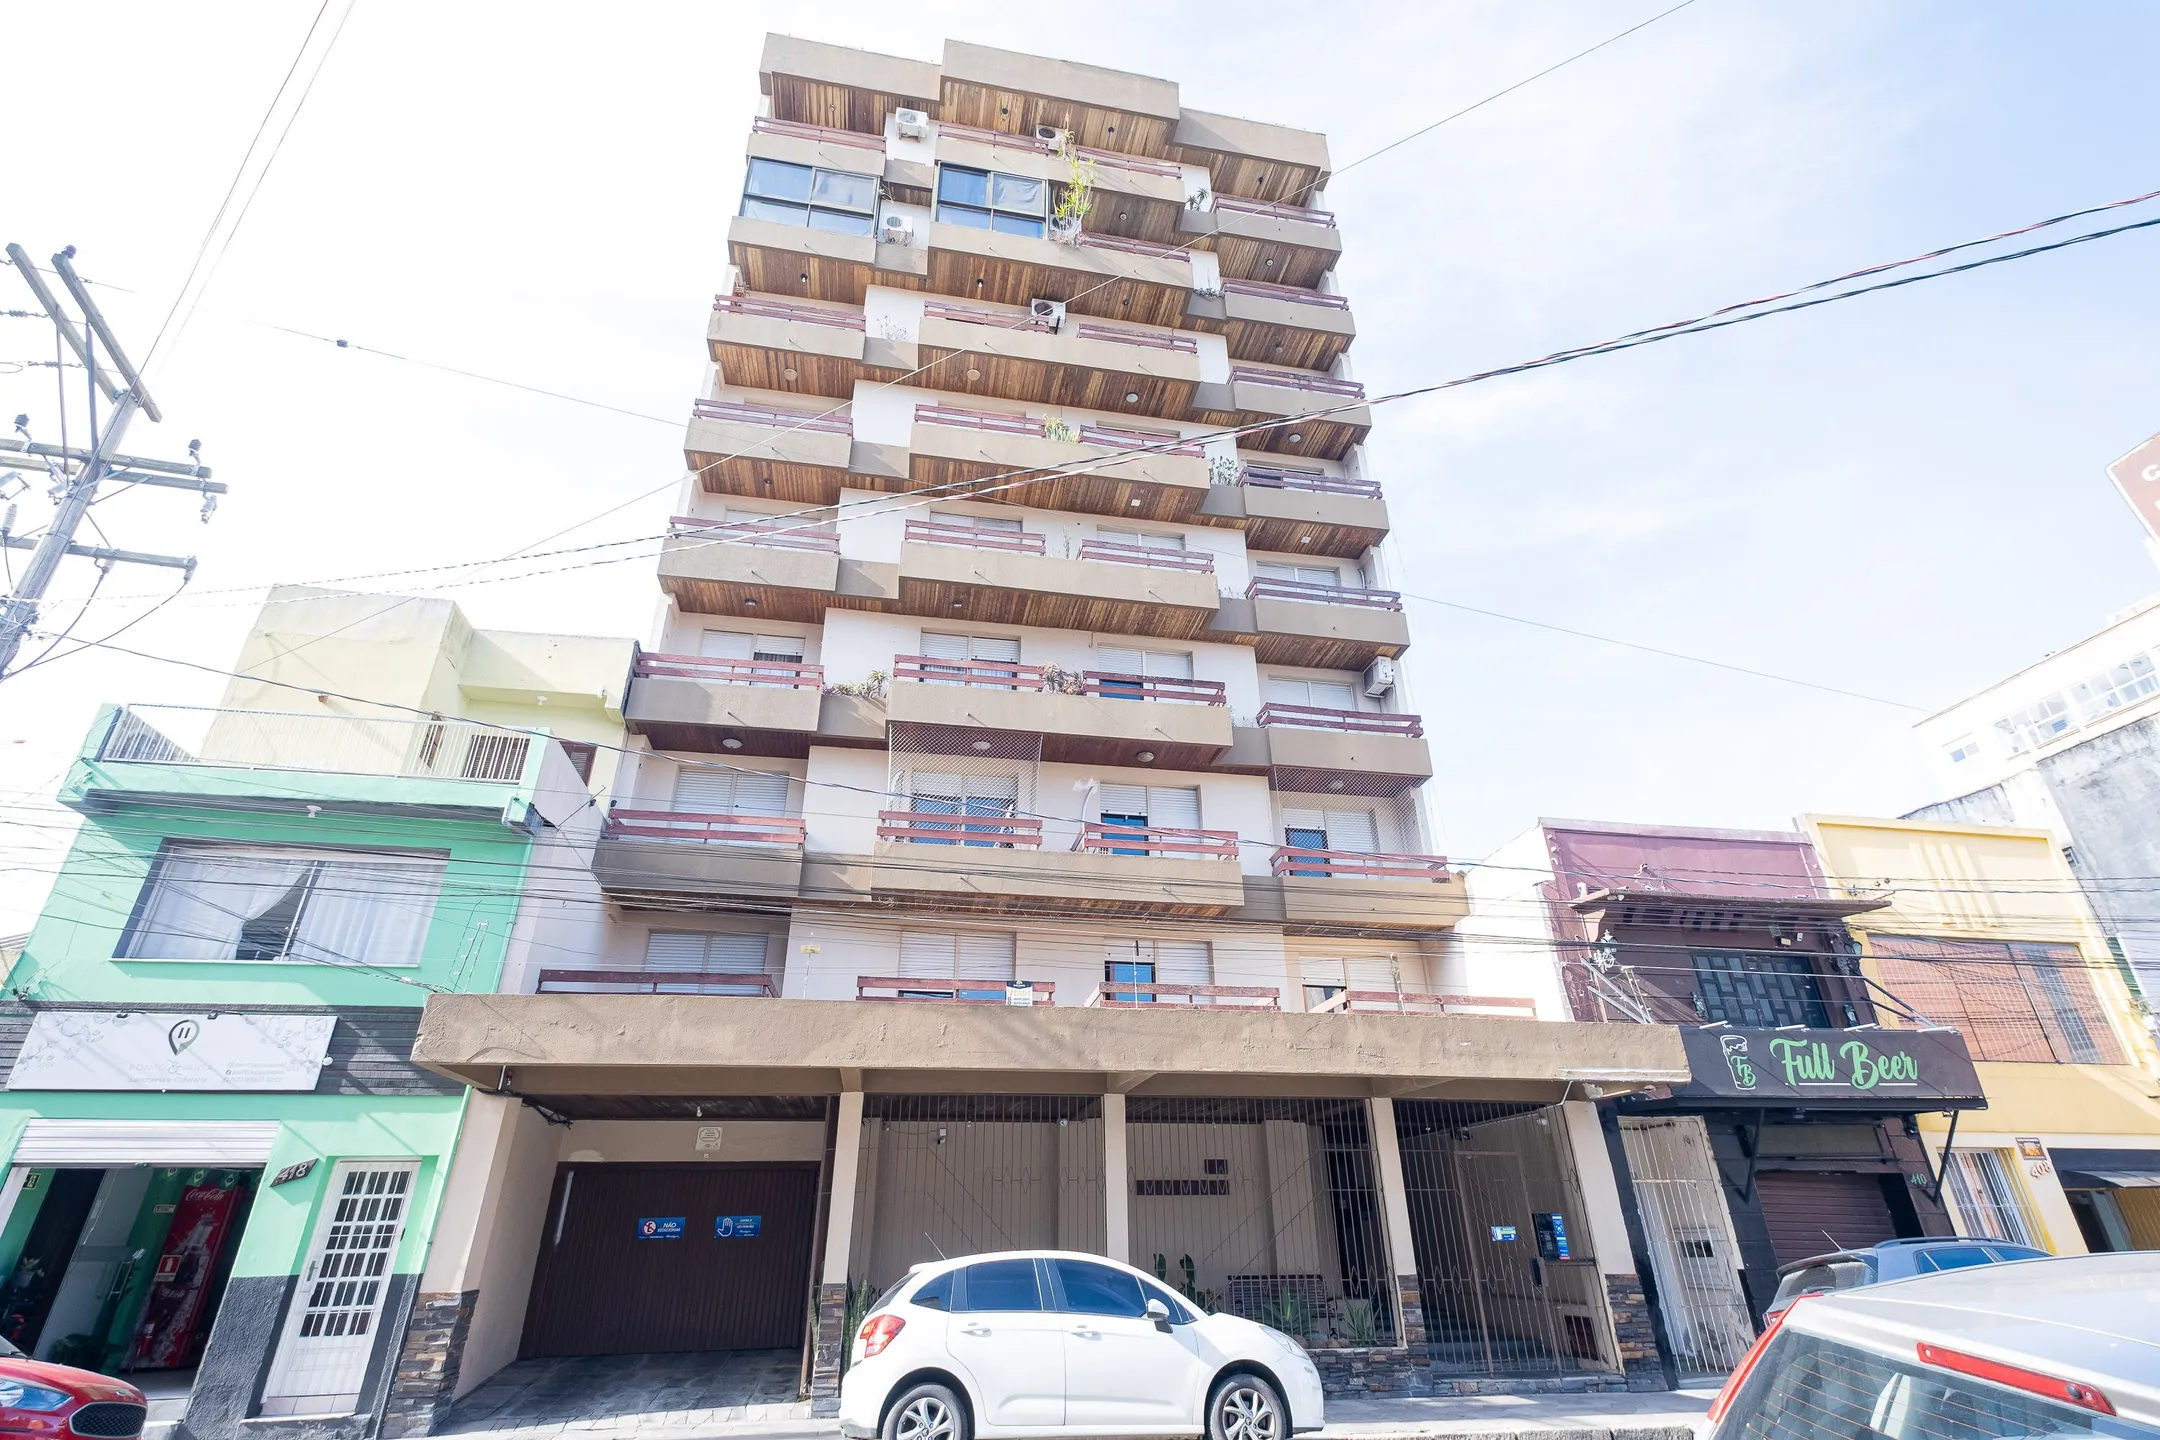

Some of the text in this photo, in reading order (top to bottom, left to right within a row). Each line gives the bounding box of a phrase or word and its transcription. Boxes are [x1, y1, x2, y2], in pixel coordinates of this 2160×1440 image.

[1769, 1038, 1918, 1090] Full Beer
[277, 1162, 308, 1181] 418
[1910, 1173, 1927, 1185] 410
[2030, 1160, 2051, 1179] 408
